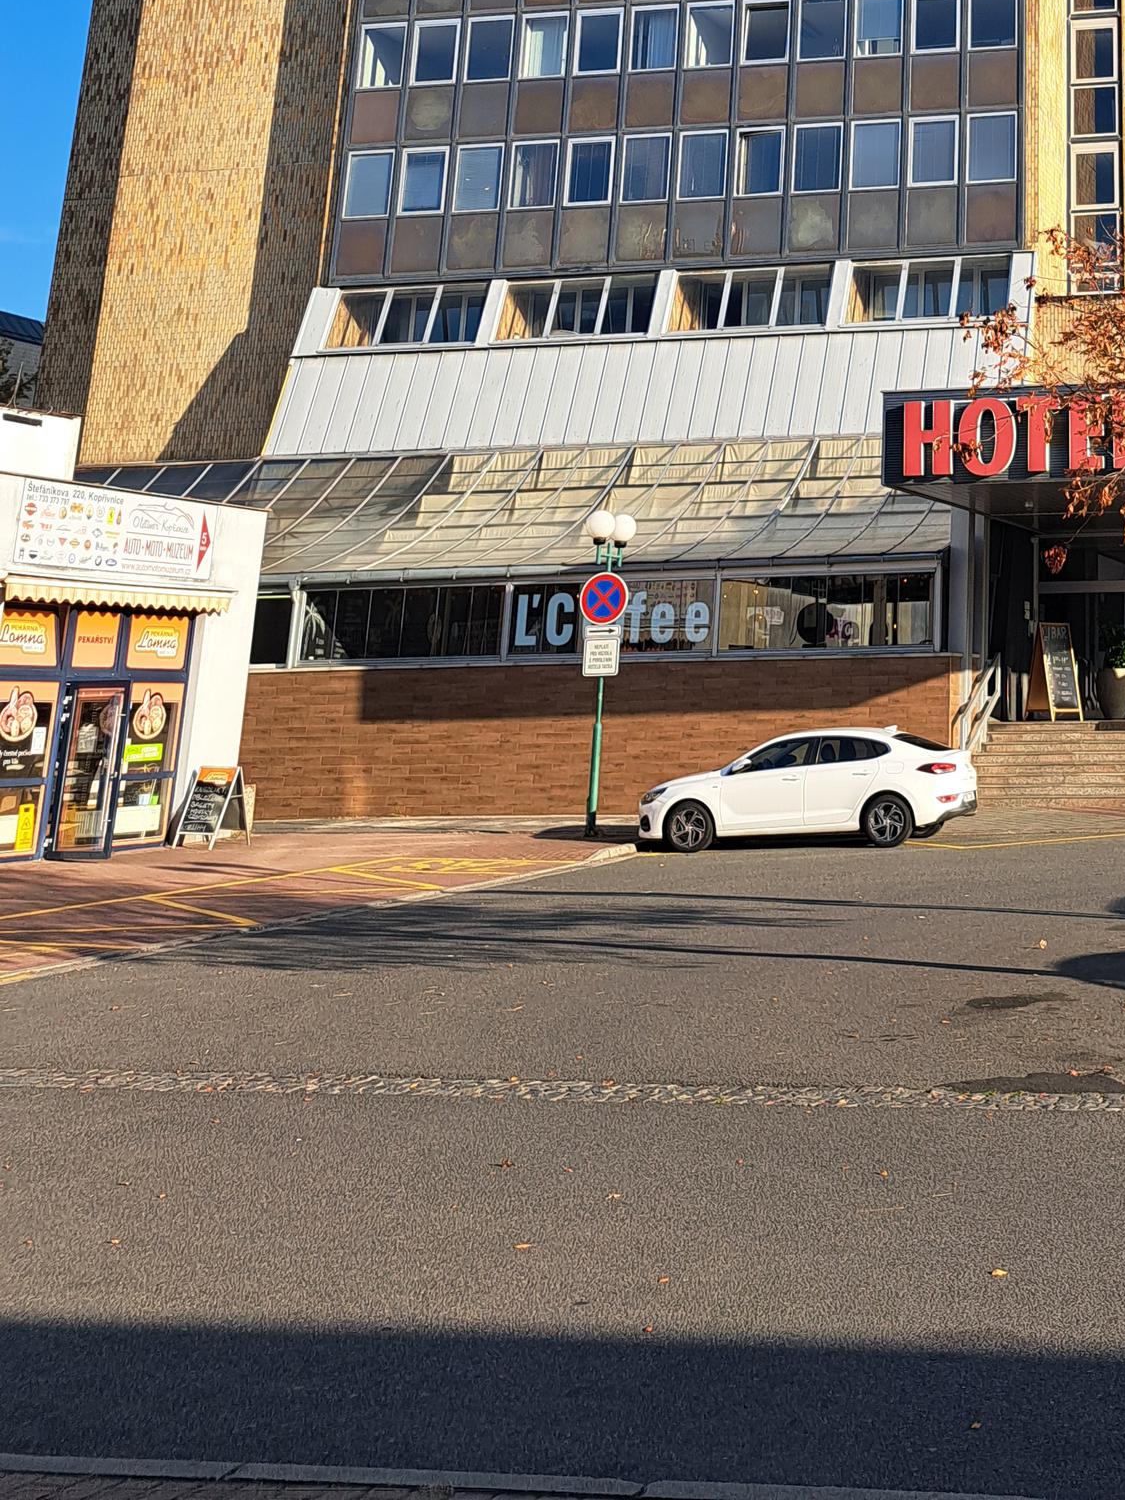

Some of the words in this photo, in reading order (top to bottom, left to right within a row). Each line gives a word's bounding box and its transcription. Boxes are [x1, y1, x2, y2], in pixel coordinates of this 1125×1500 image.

[201, 532, 208, 545] 5
[514, 591, 710, 646] L'Cfee
[77, 635, 114, 645] PEKAŘSTVÍ
